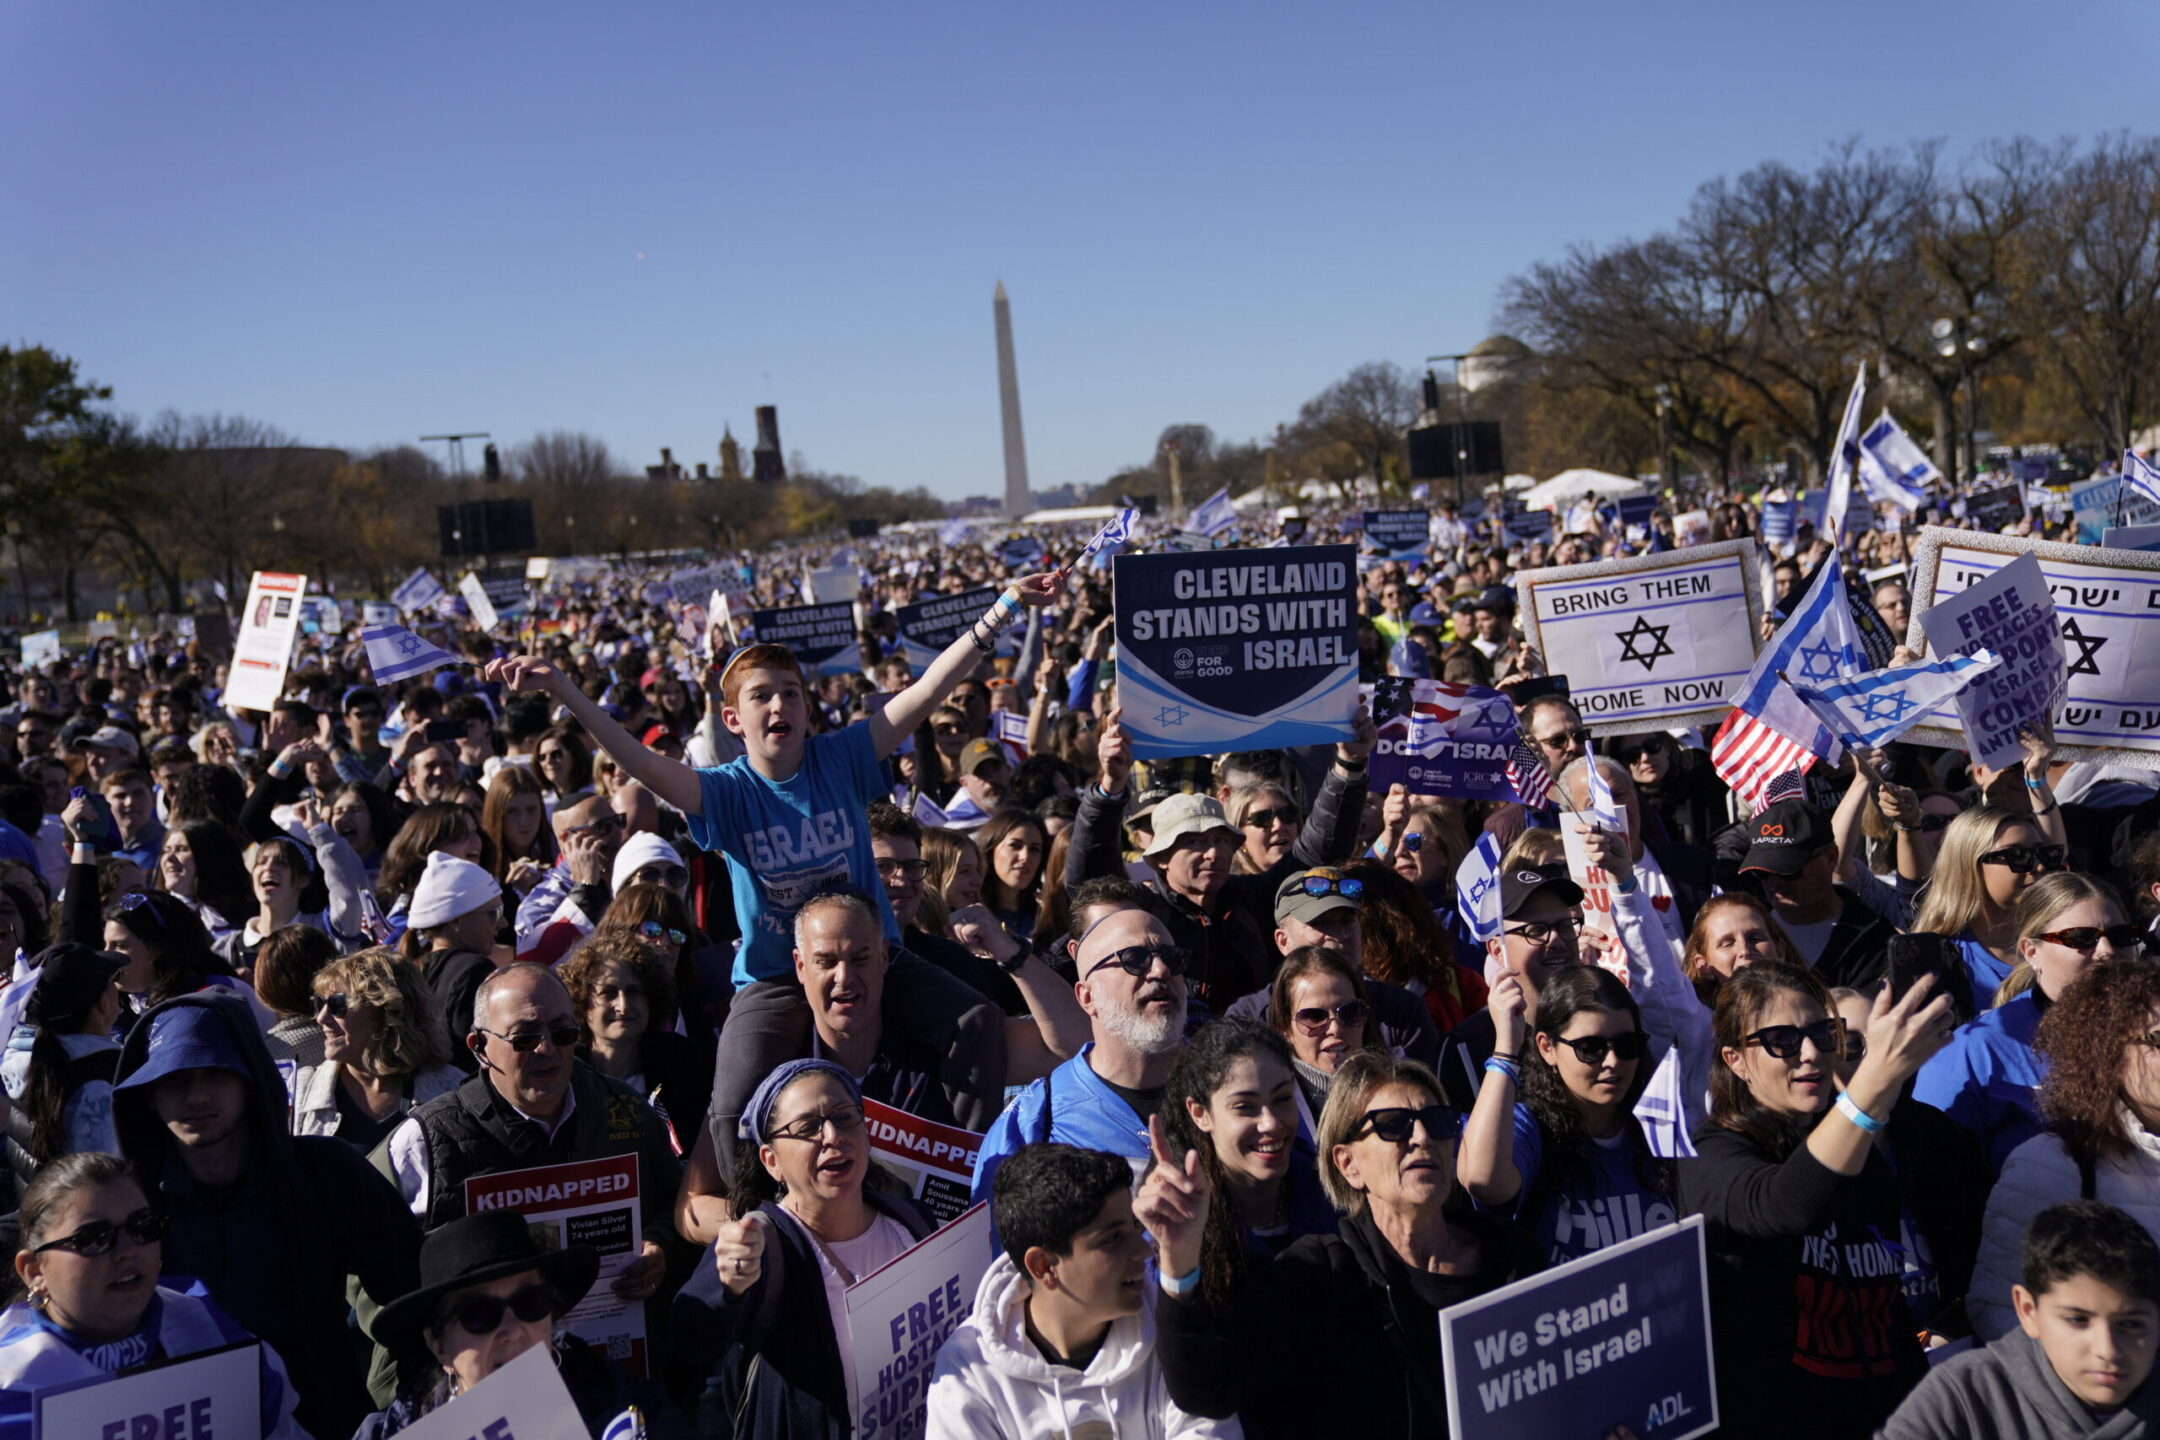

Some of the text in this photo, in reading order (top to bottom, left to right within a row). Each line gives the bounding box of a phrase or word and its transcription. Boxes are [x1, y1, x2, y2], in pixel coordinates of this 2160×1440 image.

[1173, 561, 1346, 600] CLEVELAND
[1552, 574, 1712, 615] BRING THEM
[776, 604, 850, 626] CLEVELAND
[920, 590, 996, 619] CLEVELAND
[1132, 598, 1347, 641] STANDS WITH
[1956, 586, 2024, 640] FREE
[760, 619, 851, 641] STANDS WITH
[808, 634, 851, 648] ISRAEL
[906, 613, 962, 637] STANDS
[1849, 594, 1895, 657] Antisemiti
[1954, 602, 2043, 659] HOSTAGES
[1197, 656, 1222, 667] FOR
[1197, 666, 1233, 677] GOOD
[1244, 635, 1350, 671] ISRAEL
[1956, 612, 2060, 697] UPORT
[1989, 654, 2050, 700] ISRAEL
[1574, 680, 1724, 714] HOME NOW
[1979, 660, 2064, 733] COMBAT
[1452, 742, 1518, 760] ISRA
[743, 807, 855, 871] ISRAEL
[1752, 836, 1793, 845] LAPIZTA
[769, 887, 793, 899] EST
[864, 1116, 981, 1169] IDNAPPE
[476, 1172, 630, 1212] KIDNAPPED
[926, 1187, 969, 1206] Soussana
[929, 1179, 951, 1191] Amit
[571, 1214, 627, 1230] Vivian Silver
[924, 1197, 935, 1205] 40
[936, 1202, 960, 1213] years
[1554, 1193, 1676, 1250] Hille
[571, 1224, 626, 1240] 74 years old
[595, 1240, 630, 1252] Canadian
[889, 1273, 962, 1354] FREE
[1473, 1329, 1528, 1370] We
[1534, 1282, 1629, 1347] Stand
[1477, 1316, 1652, 1414] With Israel
[861, 1361, 935, 1440] SUPP
[1645, 1391, 1692, 1431] ADL
[895, 1403, 927, 1440] ISR
